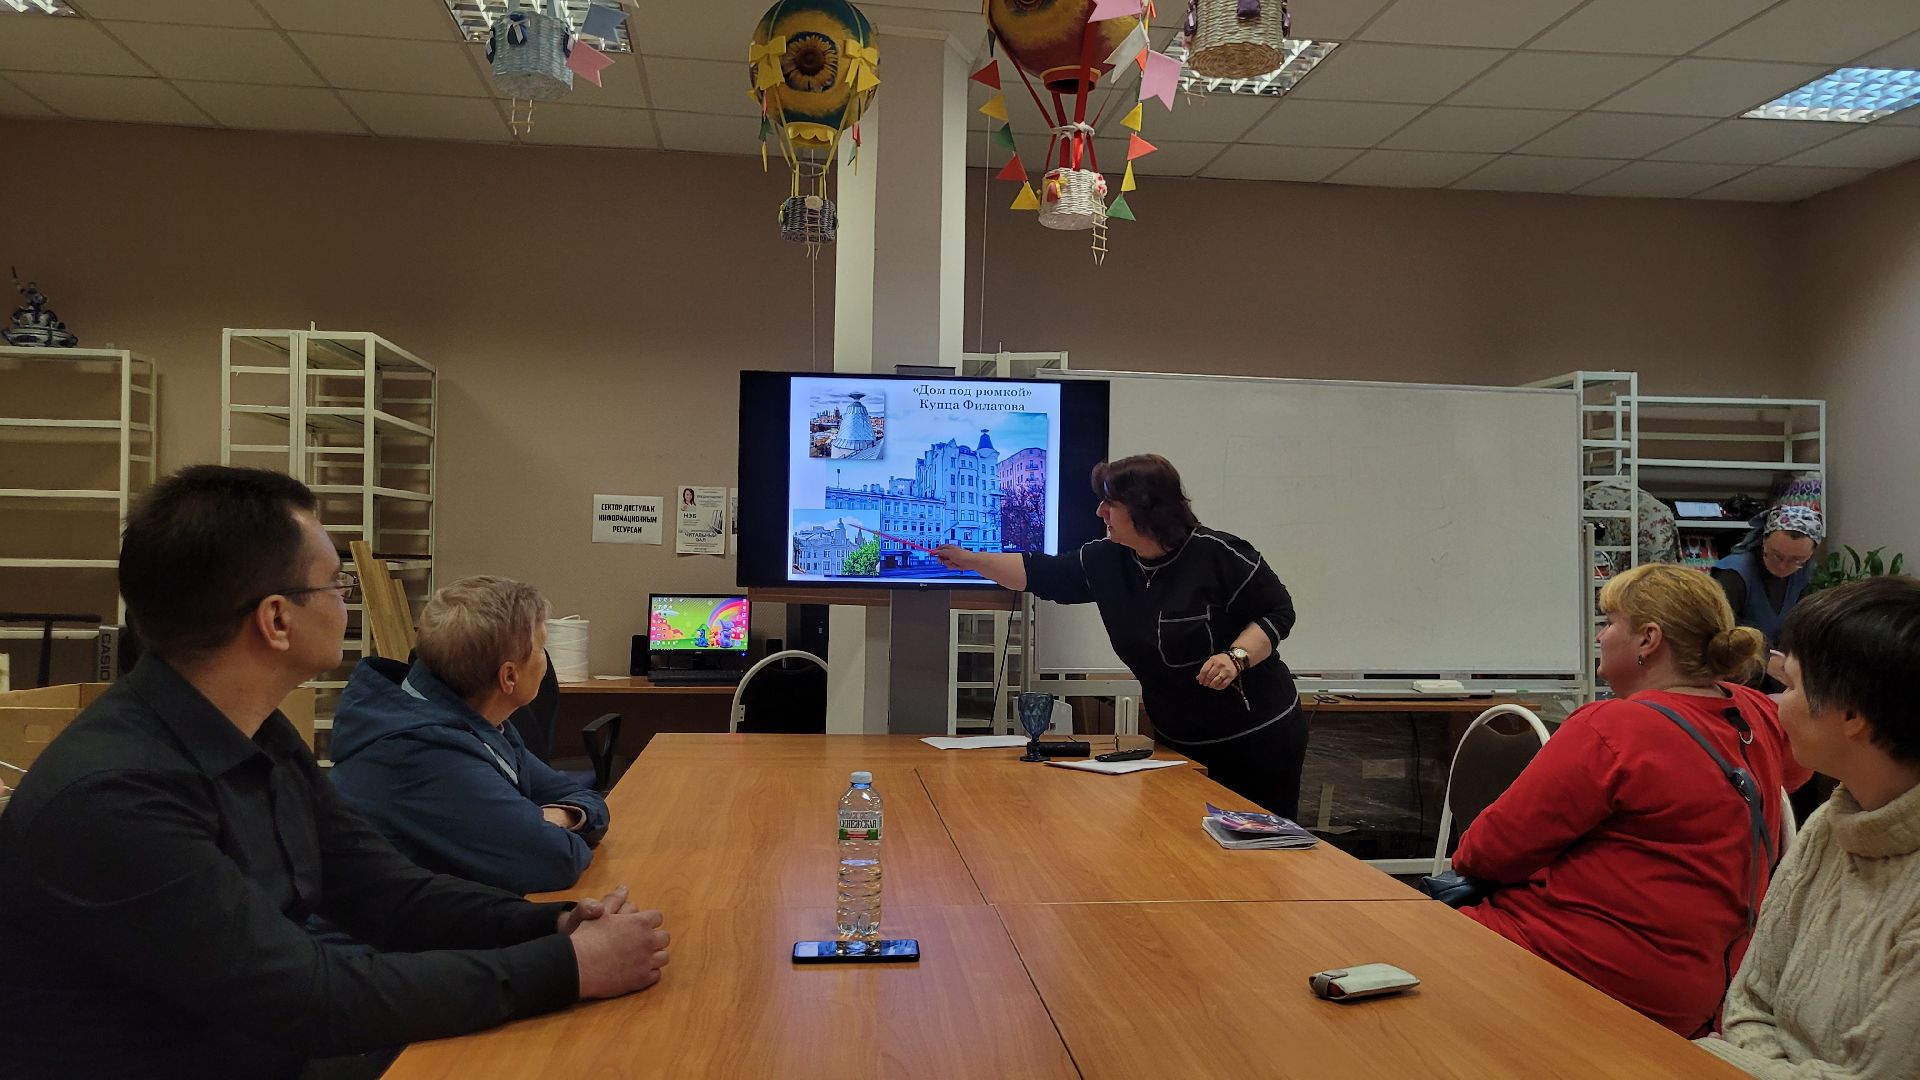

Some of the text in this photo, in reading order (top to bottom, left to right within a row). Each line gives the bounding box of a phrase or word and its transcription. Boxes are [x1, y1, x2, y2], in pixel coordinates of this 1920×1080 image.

[912, 384, 1032, 398] «Дом под рюмкой»
[919, 399, 1025, 411] Купца Филатова
[601, 503, 623, 511] СЕКТОР
[623, 504, 650, 513] ДОСТУПА
[598, 514, 657, 523] ИНФОРМАЦИОННЫМ
[100, 633, 111, 681] CASIO
